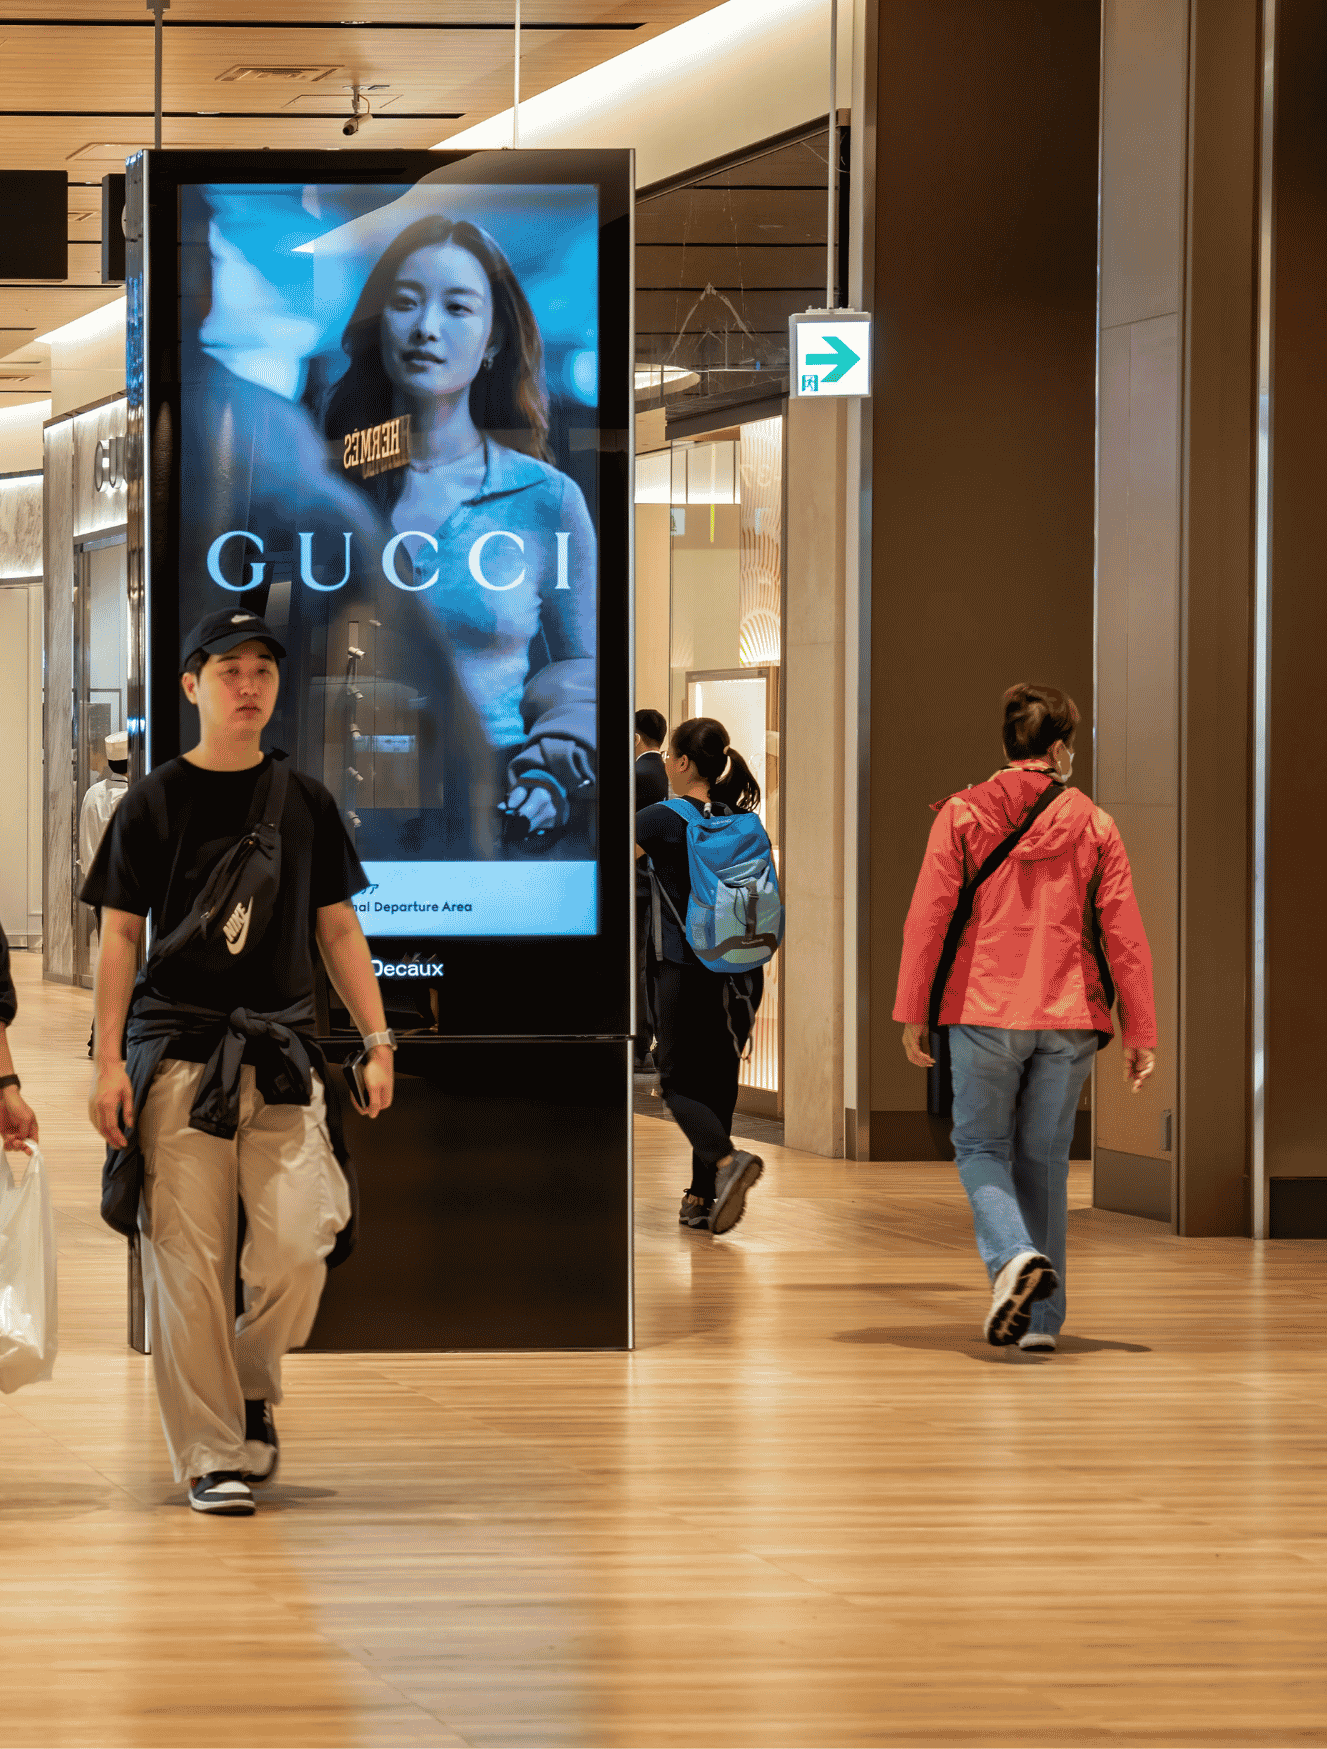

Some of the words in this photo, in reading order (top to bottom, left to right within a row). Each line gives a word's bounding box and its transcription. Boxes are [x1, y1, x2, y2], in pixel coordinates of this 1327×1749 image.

[206, 530, 572, 593] GUCCI
[223, 902, 246, 943] NIKE
[353, 901, 371, 912] nal
[374, 901, 439, 915] Departure
[442, 901, 472, 912] Area
[371, 959, 444, 976] Decaux
